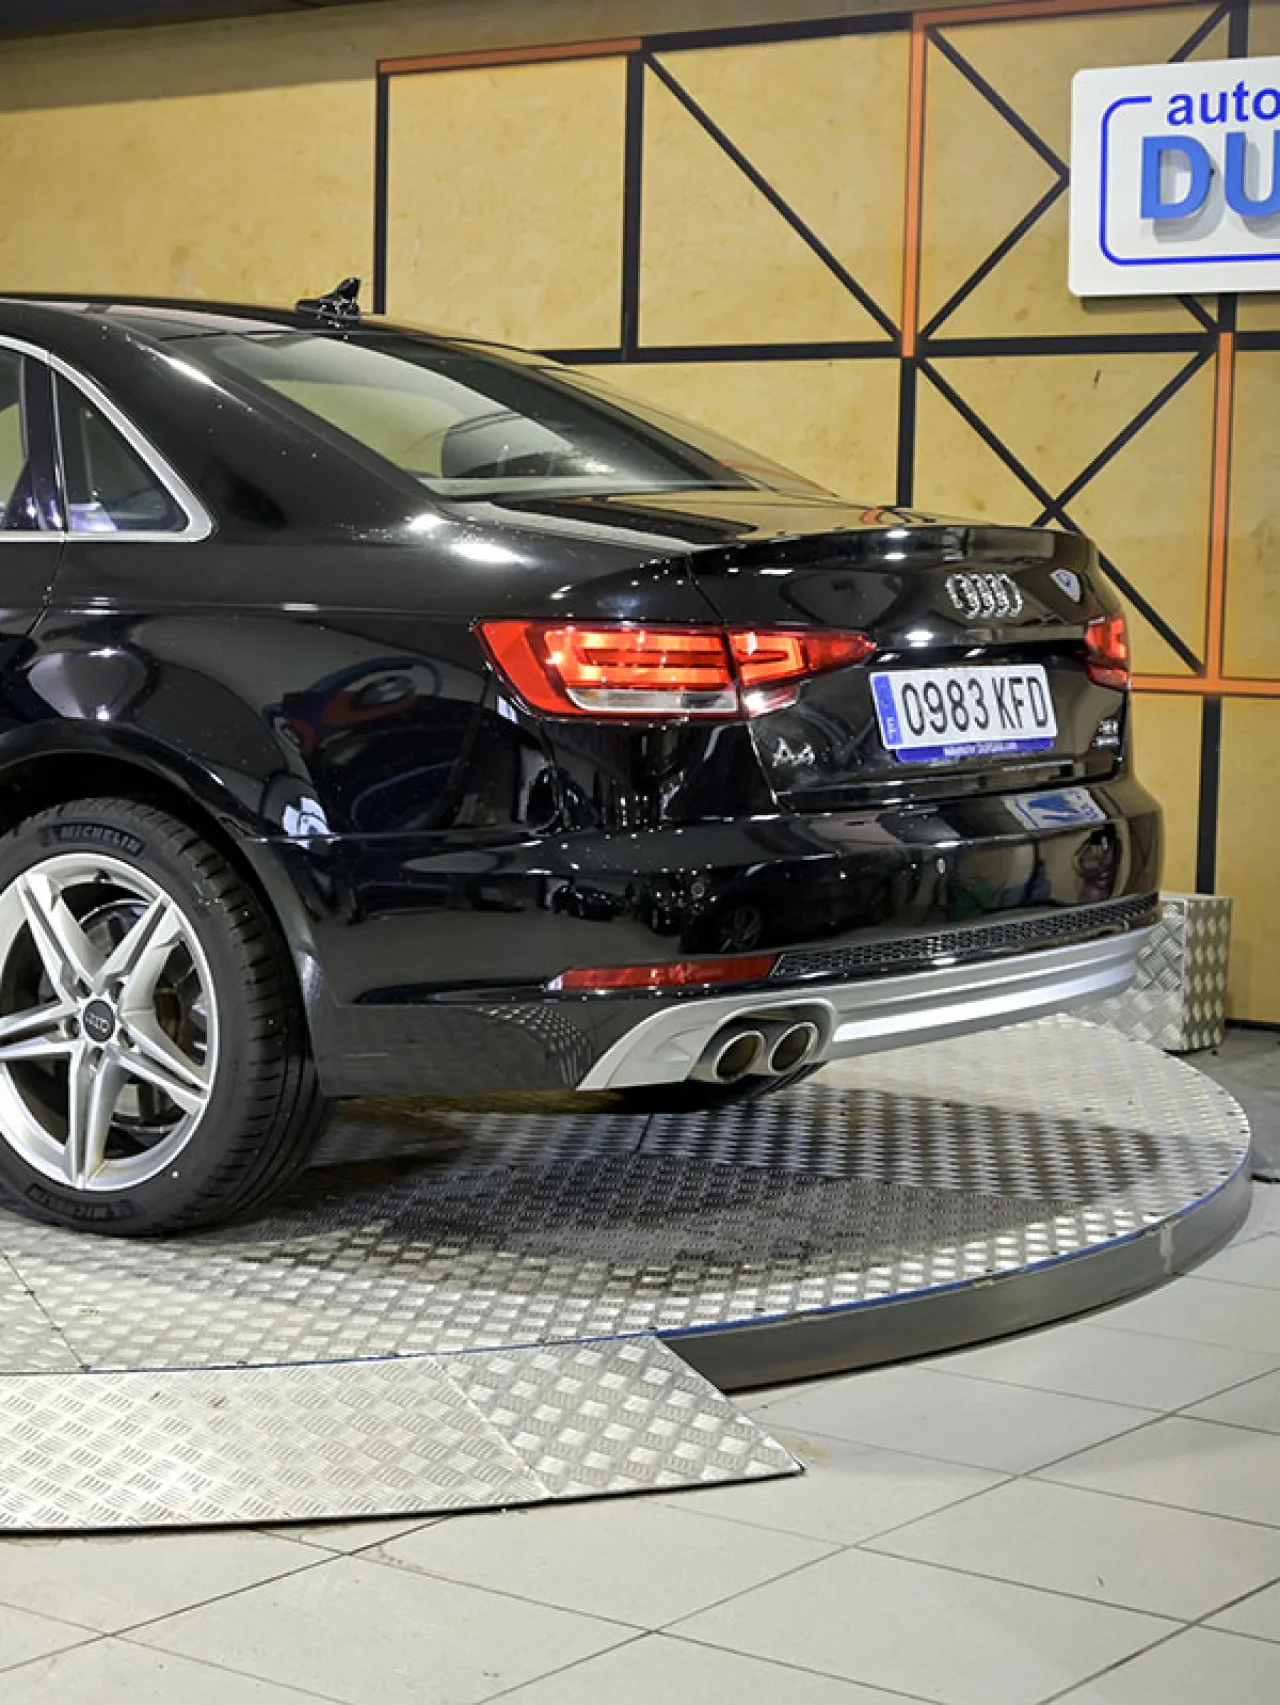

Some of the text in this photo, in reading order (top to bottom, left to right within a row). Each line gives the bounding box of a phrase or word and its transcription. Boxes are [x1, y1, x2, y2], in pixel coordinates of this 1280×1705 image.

[1139, 129, 1280, 220] DU
[902, 675, 1048, 736] 0983 KFD
